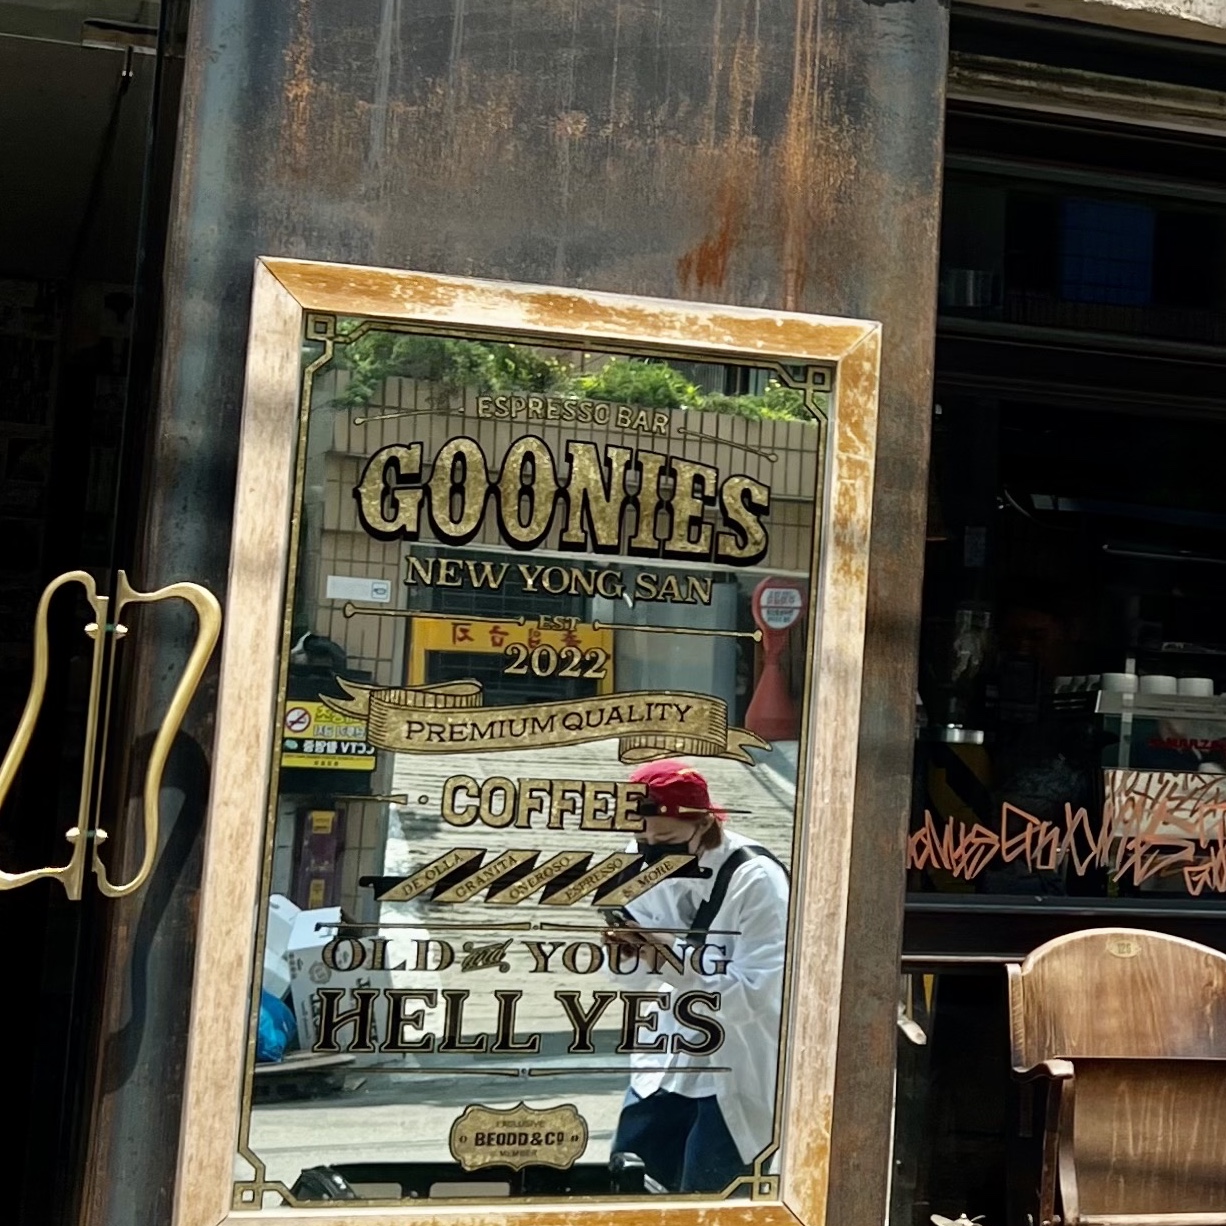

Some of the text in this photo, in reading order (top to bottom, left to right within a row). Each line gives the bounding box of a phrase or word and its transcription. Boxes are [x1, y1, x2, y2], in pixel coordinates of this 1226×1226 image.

[476, 395, 670, 435] ESPRESSO BAR
[353, 434, 771, 567] GOONIES
[405, 556, 714, 605] NEW YONG SAN
[537, 614, 581, 632] EST
[503, 641, 609, 681] 2022
[405, 703, 694, 742] PREMIUM QUALITY
[441, 774, 647, 832] COFFEE
[402, 853, 464, 897] DE OLLA
[455, 855, 518, 898] GRANITA
[508, 857, 571, 900] ONEROSO
[565, 858, 624, 901] ESPRESSO
[638, 860, 674, 889] MORE
[321, 937, 456, 973] OLD
[521, 940, 734, 977] YOUNG
[312, 988, 542, 1055] HELL
[554, 989, 726, 1057] YES
